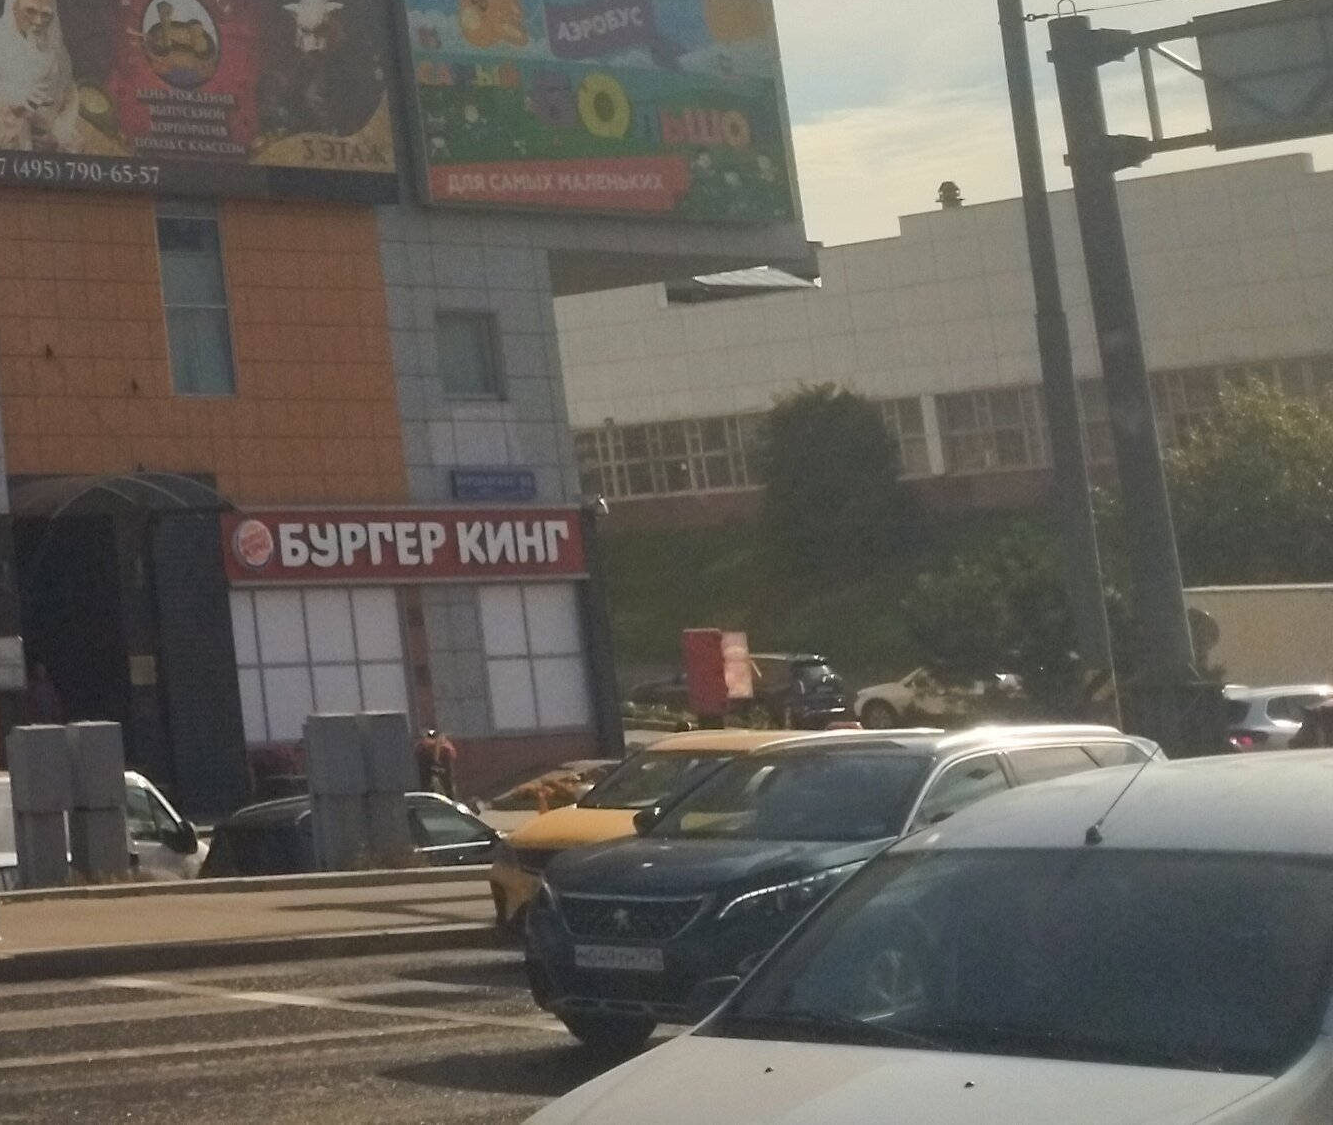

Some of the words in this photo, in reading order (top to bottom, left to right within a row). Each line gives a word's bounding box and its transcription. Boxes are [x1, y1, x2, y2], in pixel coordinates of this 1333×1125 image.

[557, 6, 643, 43] АЭРОБУС
[12, 159, 61, 182] (495)
[66, 160, 160, 185] 790-65-57
[489, 173, 552, 191] САМЫХ
[557, 173, 663, 192] МАЛЕНЬКИХ
[278, 522, 446, 567] БУРГЕР
[456, 520, 569, 564] КИНГ
